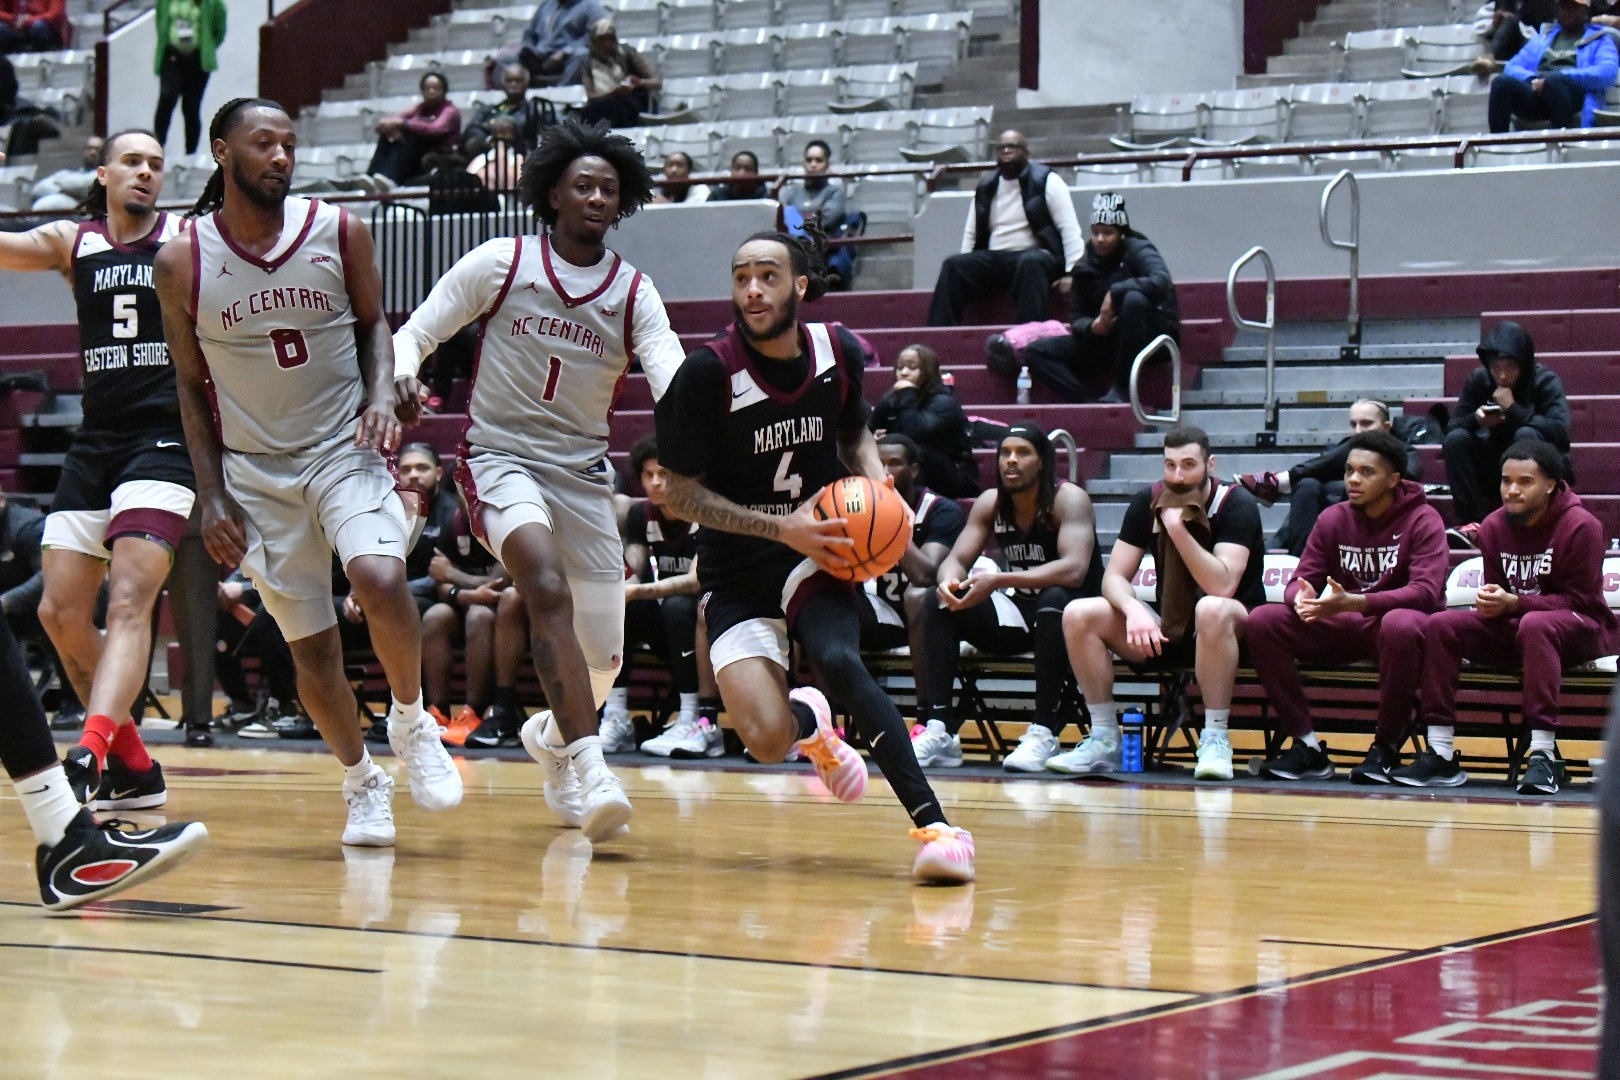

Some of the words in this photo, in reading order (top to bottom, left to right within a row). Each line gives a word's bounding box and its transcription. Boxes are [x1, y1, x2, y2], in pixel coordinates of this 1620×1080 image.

[93, 264, 155, 292] MARYLAN
[112, 293, 139, 338] 5
[221, 301, 243, 331] NC
[248, 287, 333, 315] CENTRAL
[84, 345, 128, 372] EASTERN
[133, 342, 170, 366] SHORE
[268, 327, 311, 371] 0
[511, 317, 533, 337] NC
[537, 316, 605, 358] CENTRAL
[541, 354, 563, 403] 1
[754, 416, 823, 454] MARYLAND
[773, 451, 803, 499] 4
